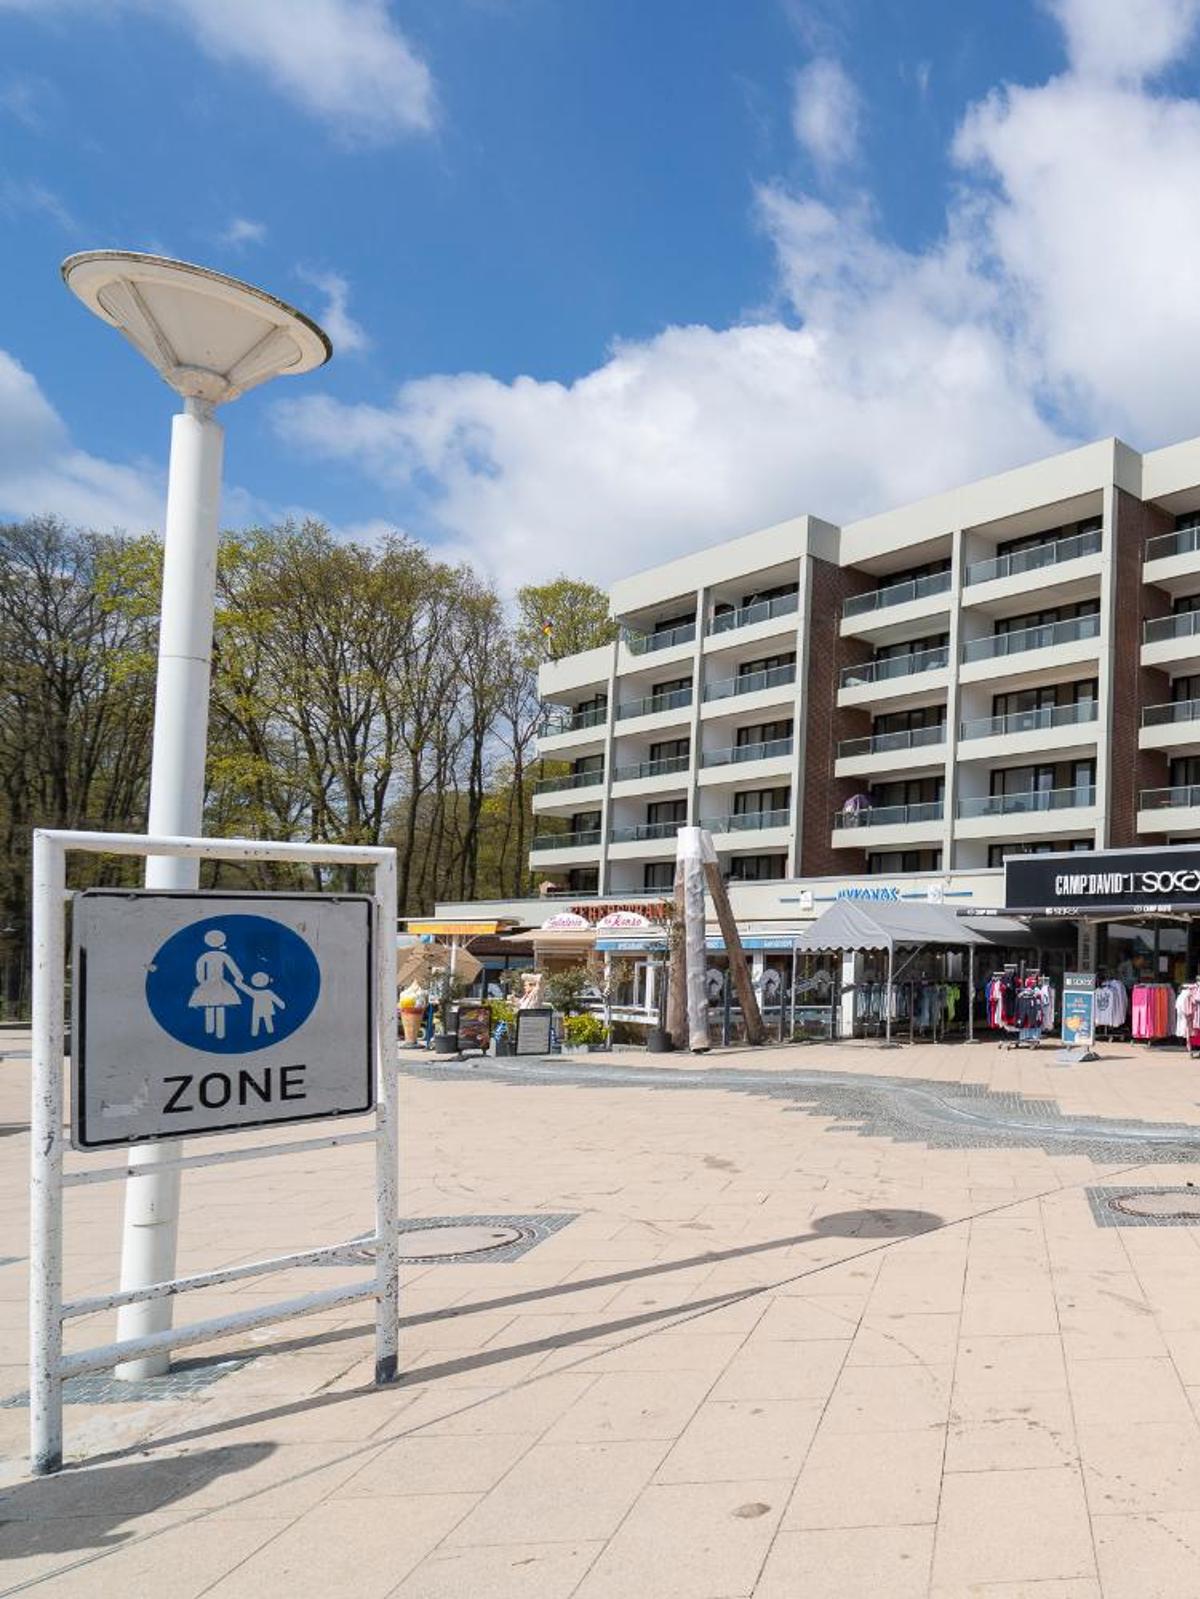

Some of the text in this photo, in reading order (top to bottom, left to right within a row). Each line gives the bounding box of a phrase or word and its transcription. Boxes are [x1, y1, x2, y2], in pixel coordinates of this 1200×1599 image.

[1055, 874, 1087, 896] CAMP
[1088, 872, 1123, 894] DAVID
[163, 1065, 306, 1114] ZONE
